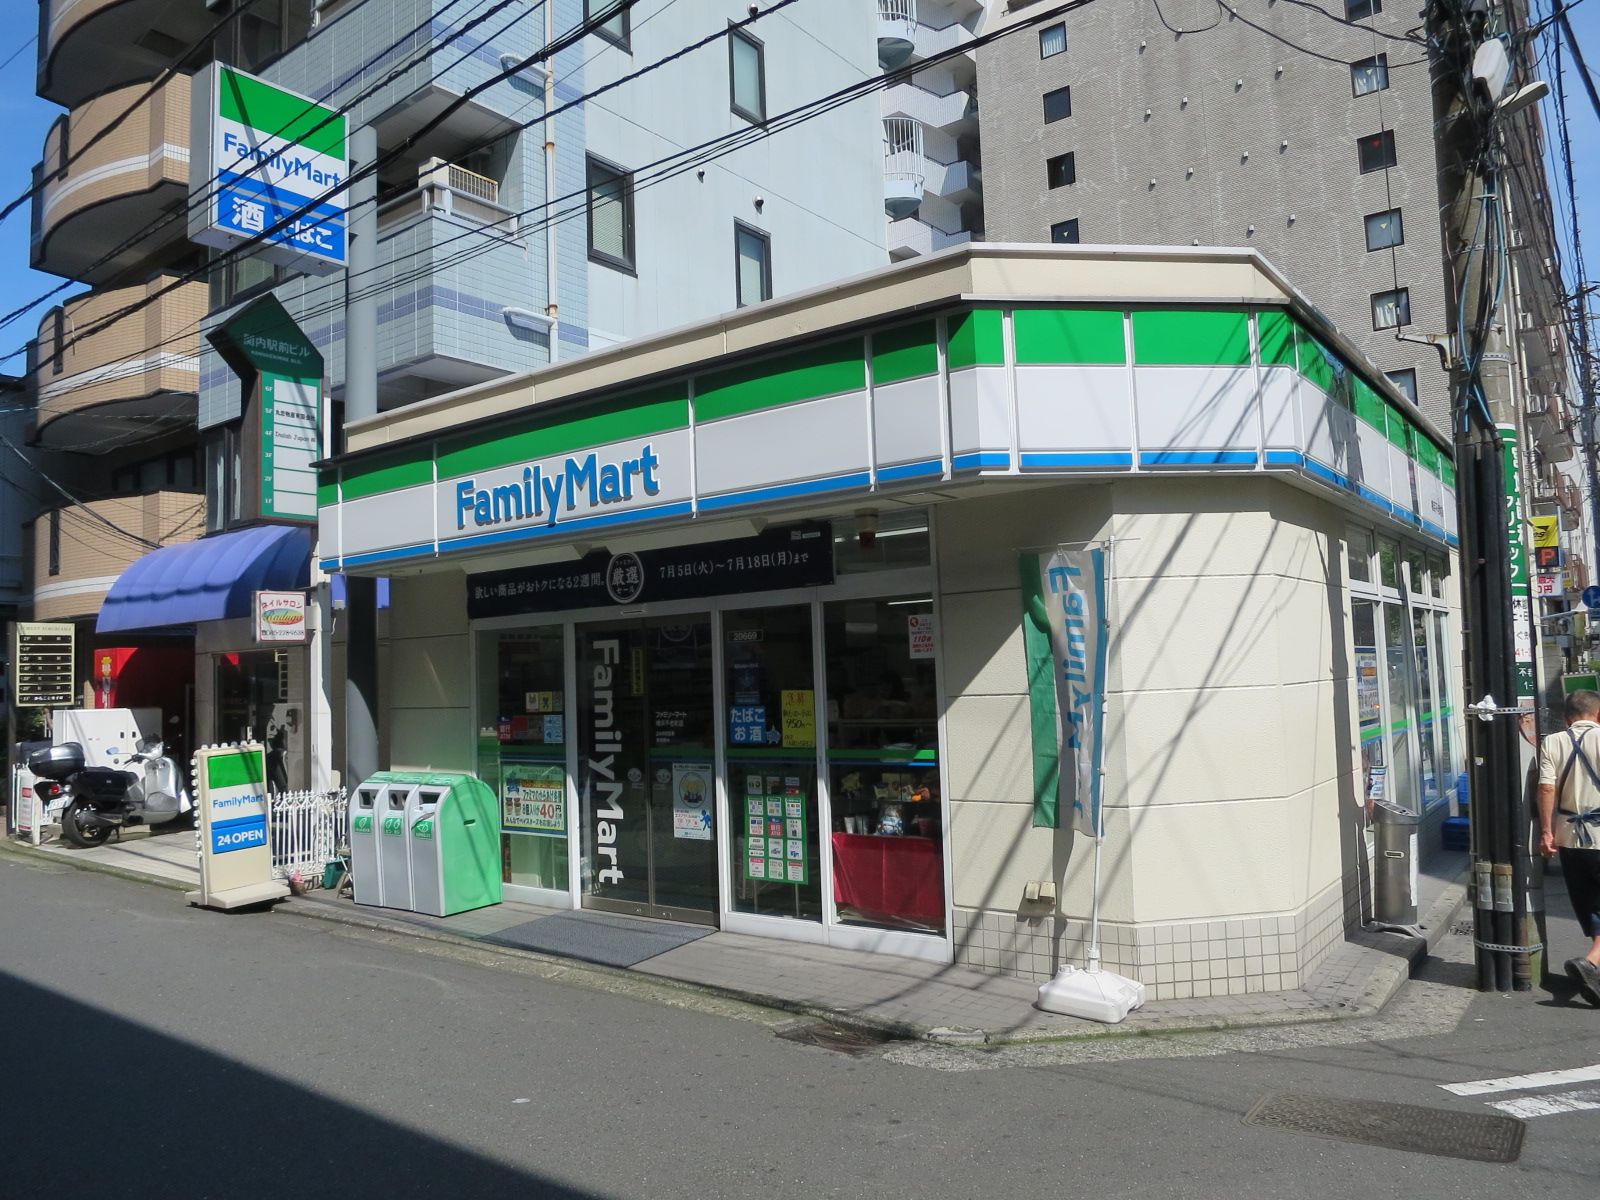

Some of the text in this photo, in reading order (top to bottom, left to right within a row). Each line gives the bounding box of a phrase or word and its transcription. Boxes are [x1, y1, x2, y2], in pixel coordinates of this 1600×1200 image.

[223, 132, 340, 187] FamilyMart
[232, 196, 266, 232] 酒
[456, 442, 661, 530] FamilyMart
[1540, 549, 1556, 566] P
[612, 566, 640, 587] 厳選
[261, 599, 304, 609] ネイルサロン
[730, 707, 766, 724] たばこ
[735, 726, 763, 741] お酒
[588, 638, 626, 885] FamilyMart
[212, 793, 264, 809] FamilyMart
[231, 829, 264, 845] OPEN
